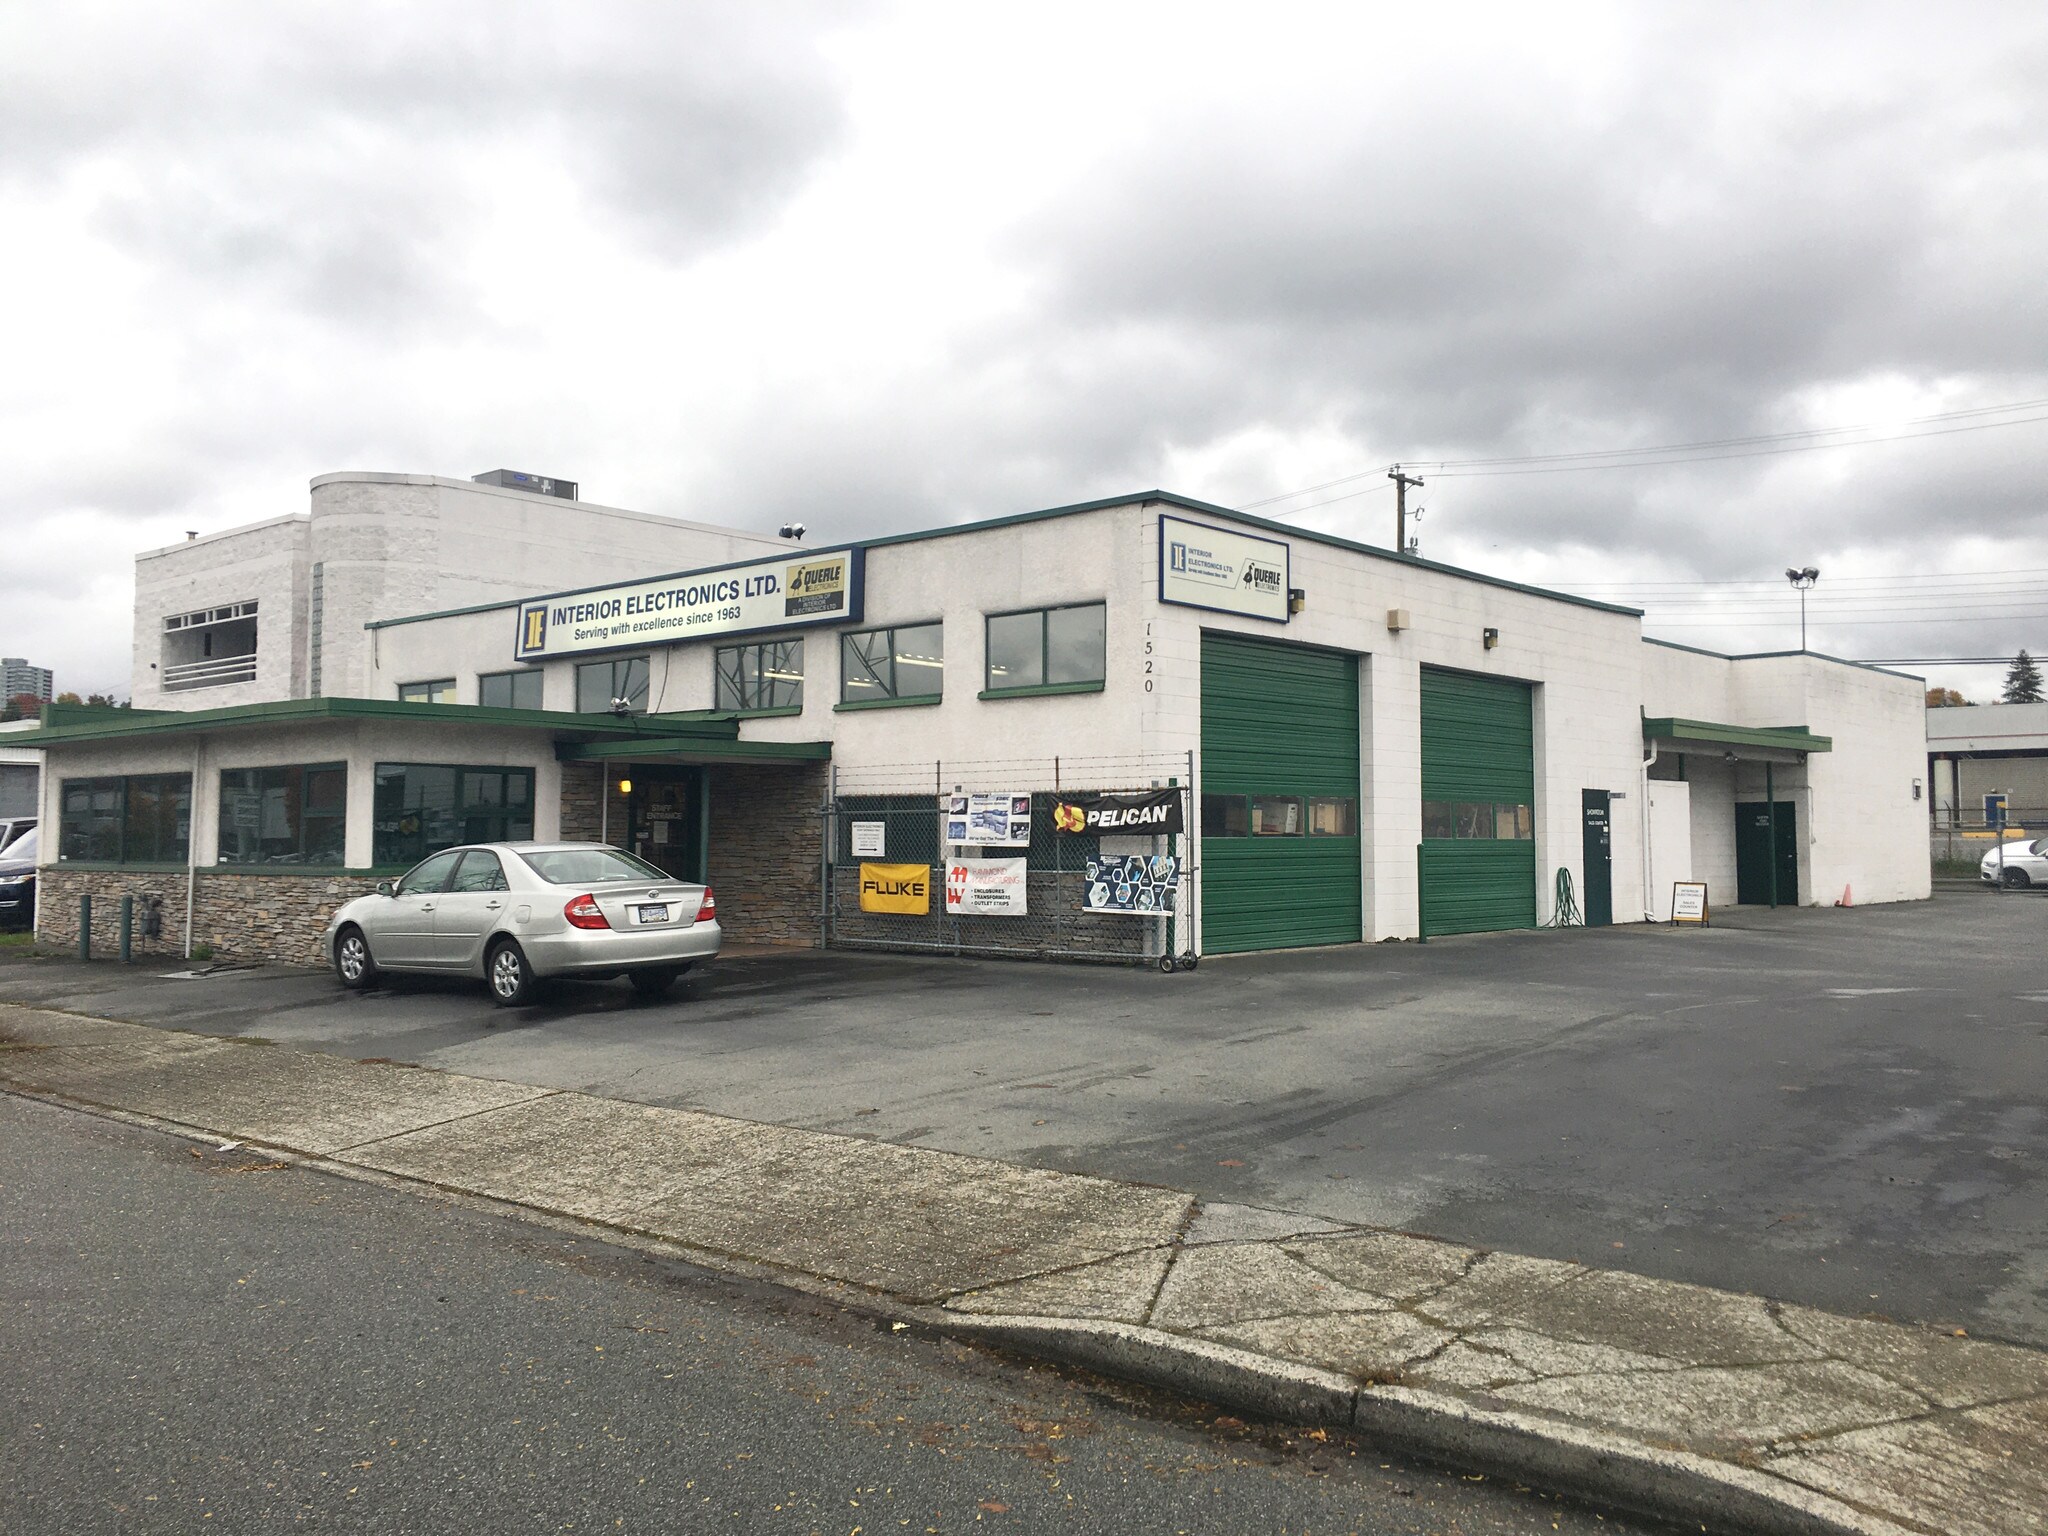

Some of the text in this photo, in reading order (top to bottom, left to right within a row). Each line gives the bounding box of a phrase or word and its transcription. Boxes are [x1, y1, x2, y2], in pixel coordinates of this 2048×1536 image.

[1188, 548, 1212, 558] INTERIOR
[1188, 558, 1222, 571] ELECTRONICS
[552, 574, 781, 626] INTERIOR ELECTRONICS LTD.
[574, 606, 741, 641] Serving with excellence since 1963
[651, 804, 672, 812] STAFF
[646, 812, 682, 820] ENTRANCE
[1086, 804, 1168, 827] PELICAN
[971, 867, 1007, 876] HAMMOND
[863, 881, 924, 897] FLUKE
